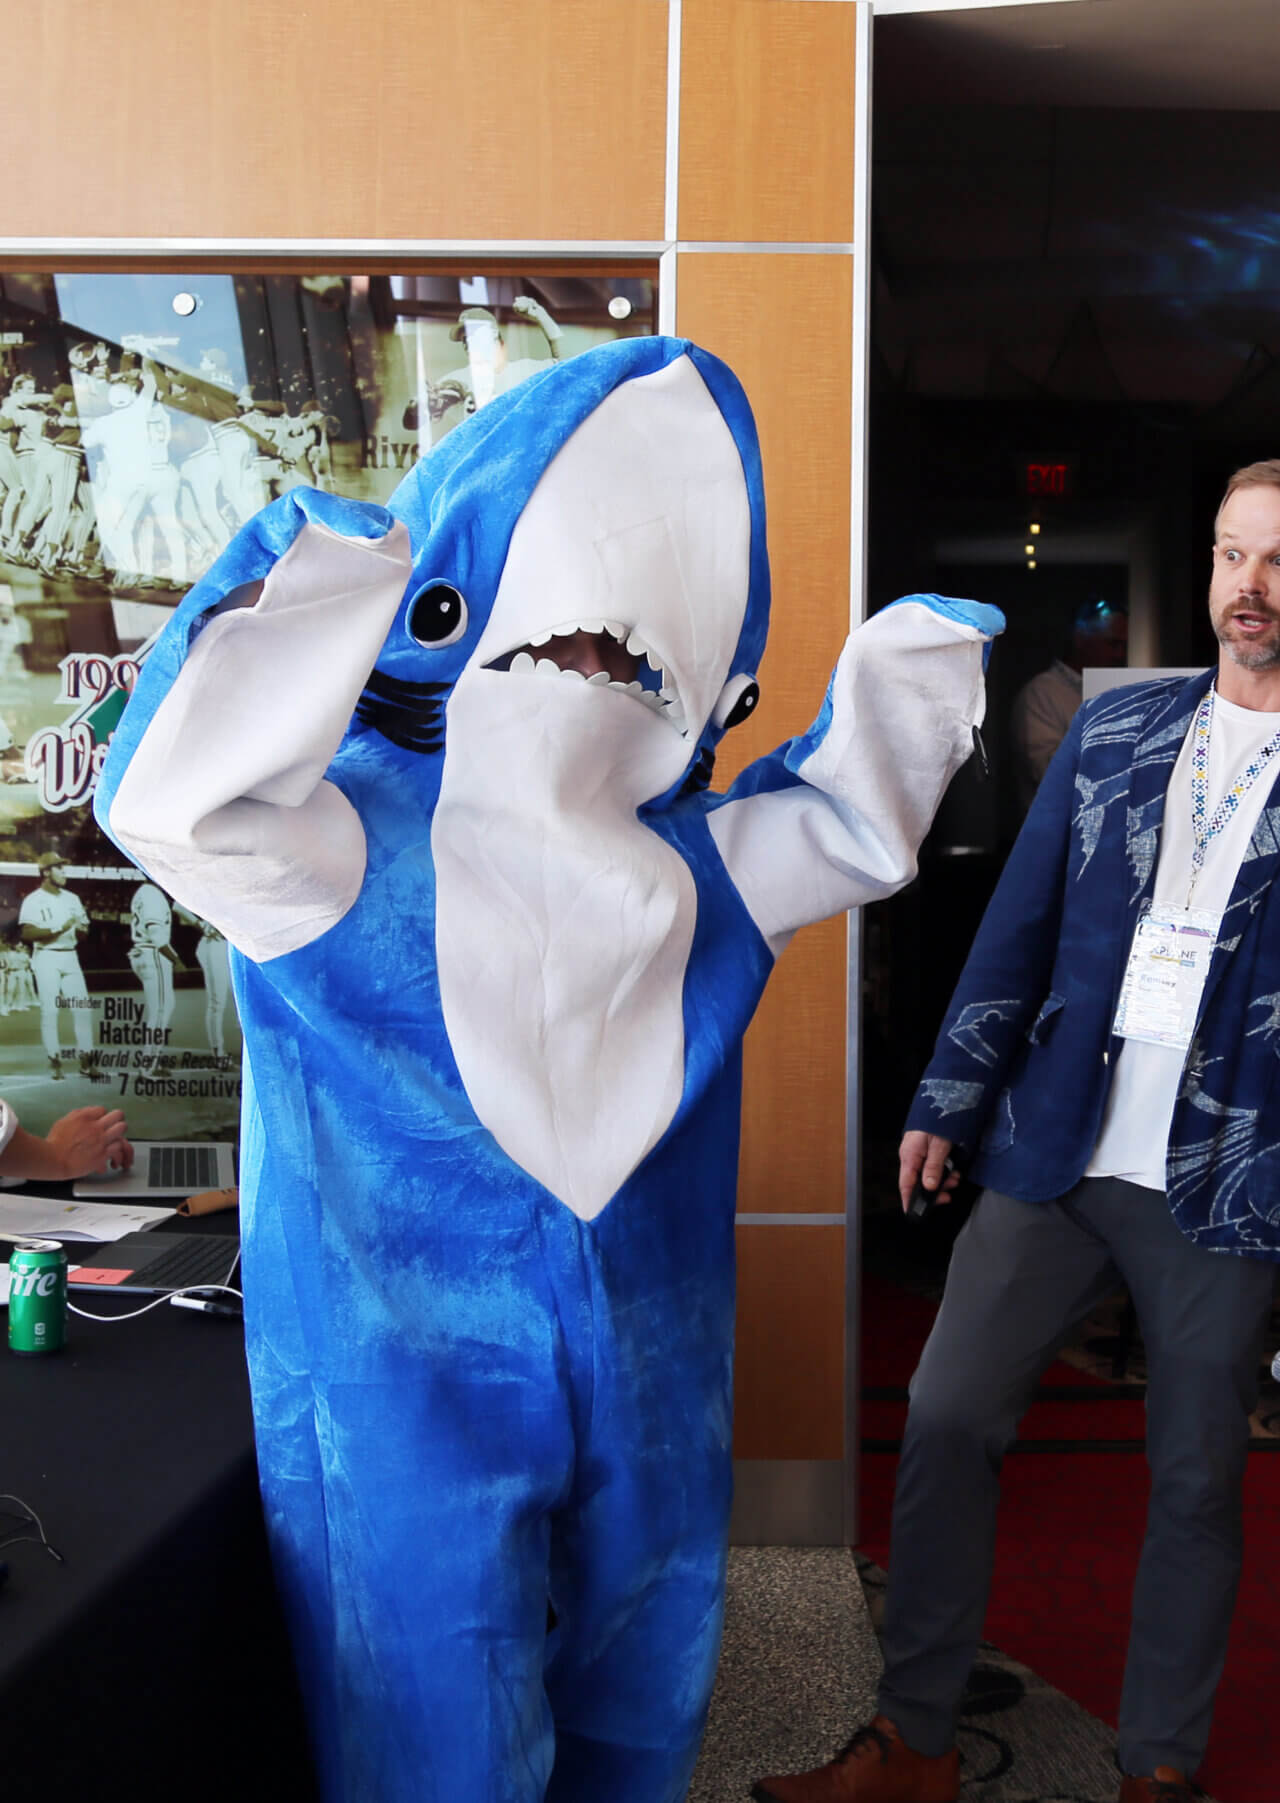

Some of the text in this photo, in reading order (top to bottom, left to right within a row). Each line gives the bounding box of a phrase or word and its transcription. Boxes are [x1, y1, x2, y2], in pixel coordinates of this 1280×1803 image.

[360, 434, 419, 468] Riv
[1027, 464, 1067, 493] EXIT
[66, 659, 141, 703] 199
[31, 721, 110, 806] Wo
[55, 996, 145, 1024] Outfielder Billy
[100, 1021, 172, 1046] Hatcher
[61, 1048, 76, 1059] set
[88, 1049, 130, 1068] World
[132, 1051, 177, 1069] Series
[181, 1052, 232, 1070] Record
[118, 1073, 129, 1096] 7
[9, 1264, 57, 1297] rite
